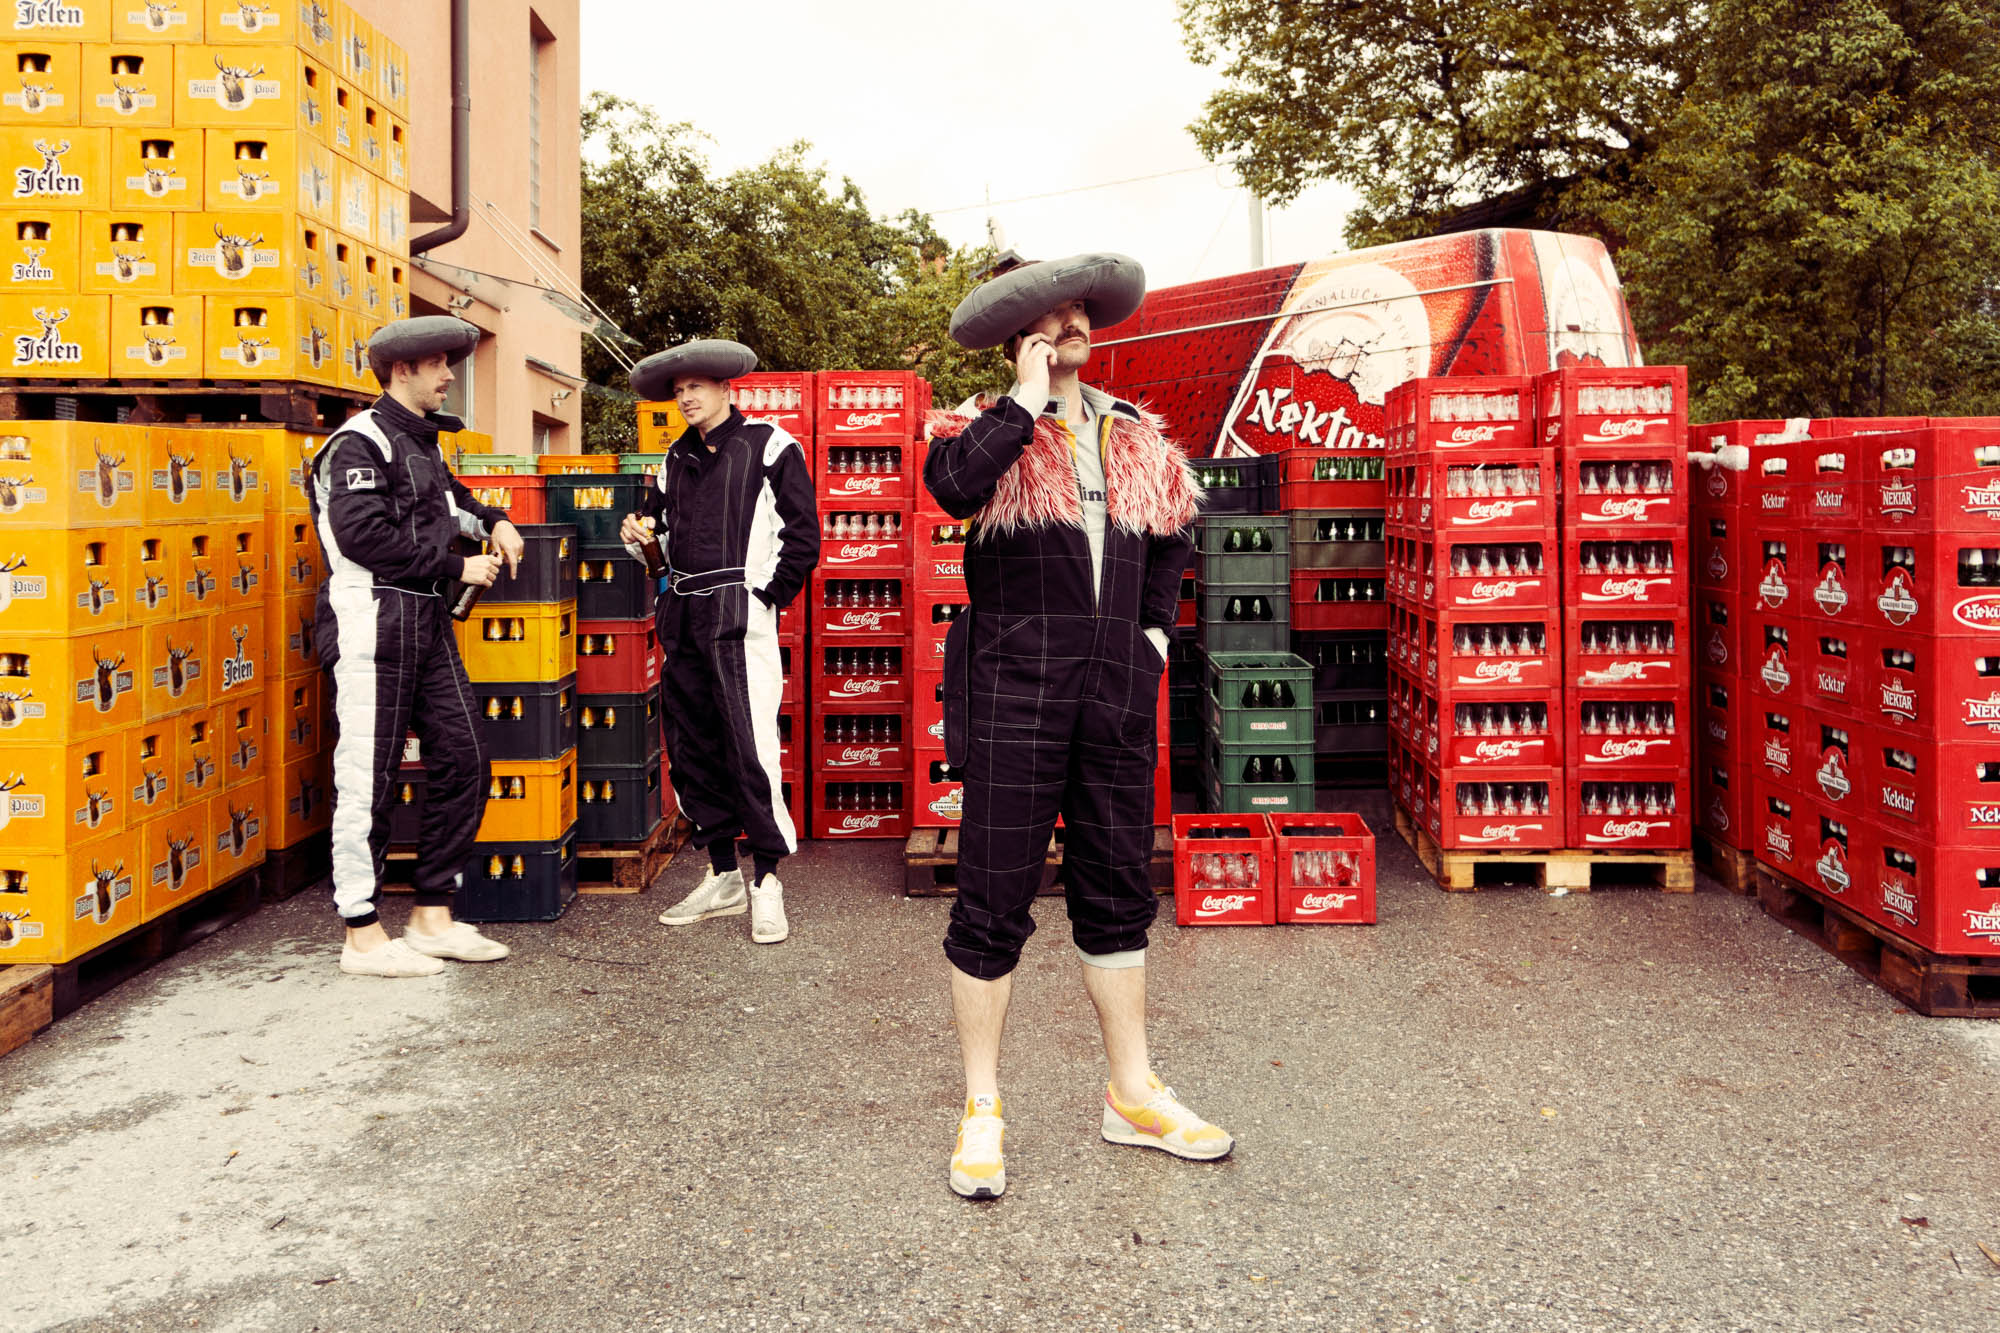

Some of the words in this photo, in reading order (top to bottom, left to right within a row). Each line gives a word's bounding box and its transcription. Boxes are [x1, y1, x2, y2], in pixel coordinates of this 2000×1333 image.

[18, 1, 81, 25] Jelen
[192, 83, 216, 94] Jelen
[254, 84, 275, 95] Pivo
[18, 169, 81, 193] Jelen
[192, 252, 216, 263] Jelen
[254, 252, 274, 263] Pivo
[15, 264, 51, 279] Jelen
[17, 337, 78, 362] Jelen
[847, 413, 882, 426] Coca-Cola
[1600, 419, 1645, 435] Coca-Cola
[1452, 426, 1494, 441] Coca-Cola
[845, 477, 880, 490] Coca-Cola
[1762, 493, 1785, 509] Nektar
[1816, 490, 1843, 507] Nektar
[1883, 491, 1912, 506] NEKTAR
[1469, 501, 1513, 518] Coca-Cola
[1601, 499, 1646, 515] Coca-Cola
[841, 544, 878, 557] Coca-Cola
[13, 581, 41, 594] Pivo
[1472, 581, 1516, 597] Coca-Cola
[1601, 579, 1646, 594] Coca-Cola
[843, 612, 880, 624] Coca-Cola
[224, 659, 252, 686] Jelen
[1475, 661, 1520, 677] Coca-Cola
[844, 679, 880, 692] Coca-Cola
[1818, 673, 1845, 694] Nektar
[1883, 690, 1912, 710] NEKTAR
[842, 747, 878, 760] Coca-Cola
[1601, 740, 1646, 755] Coca-Cola
[1766, 747, 1788, 765] NEKTAR
[12, 799, 38, 812] Pivo
[1883, 787, 1914, 813] Nektar
[842, 815, 879, 828] Coca-Cola
[1603, 821, 1648, 836] Coca-Cola
[1482, 824, 1516, 838] Coca-Cola
[1768, 832, 1789, 853] NEKTAR
[1203, 895, 1244, 910] Coca-Cola
[1303, 894, 1345, 908] Coca-Cola
[1884, 888, 1913, 915] NEKTAR
